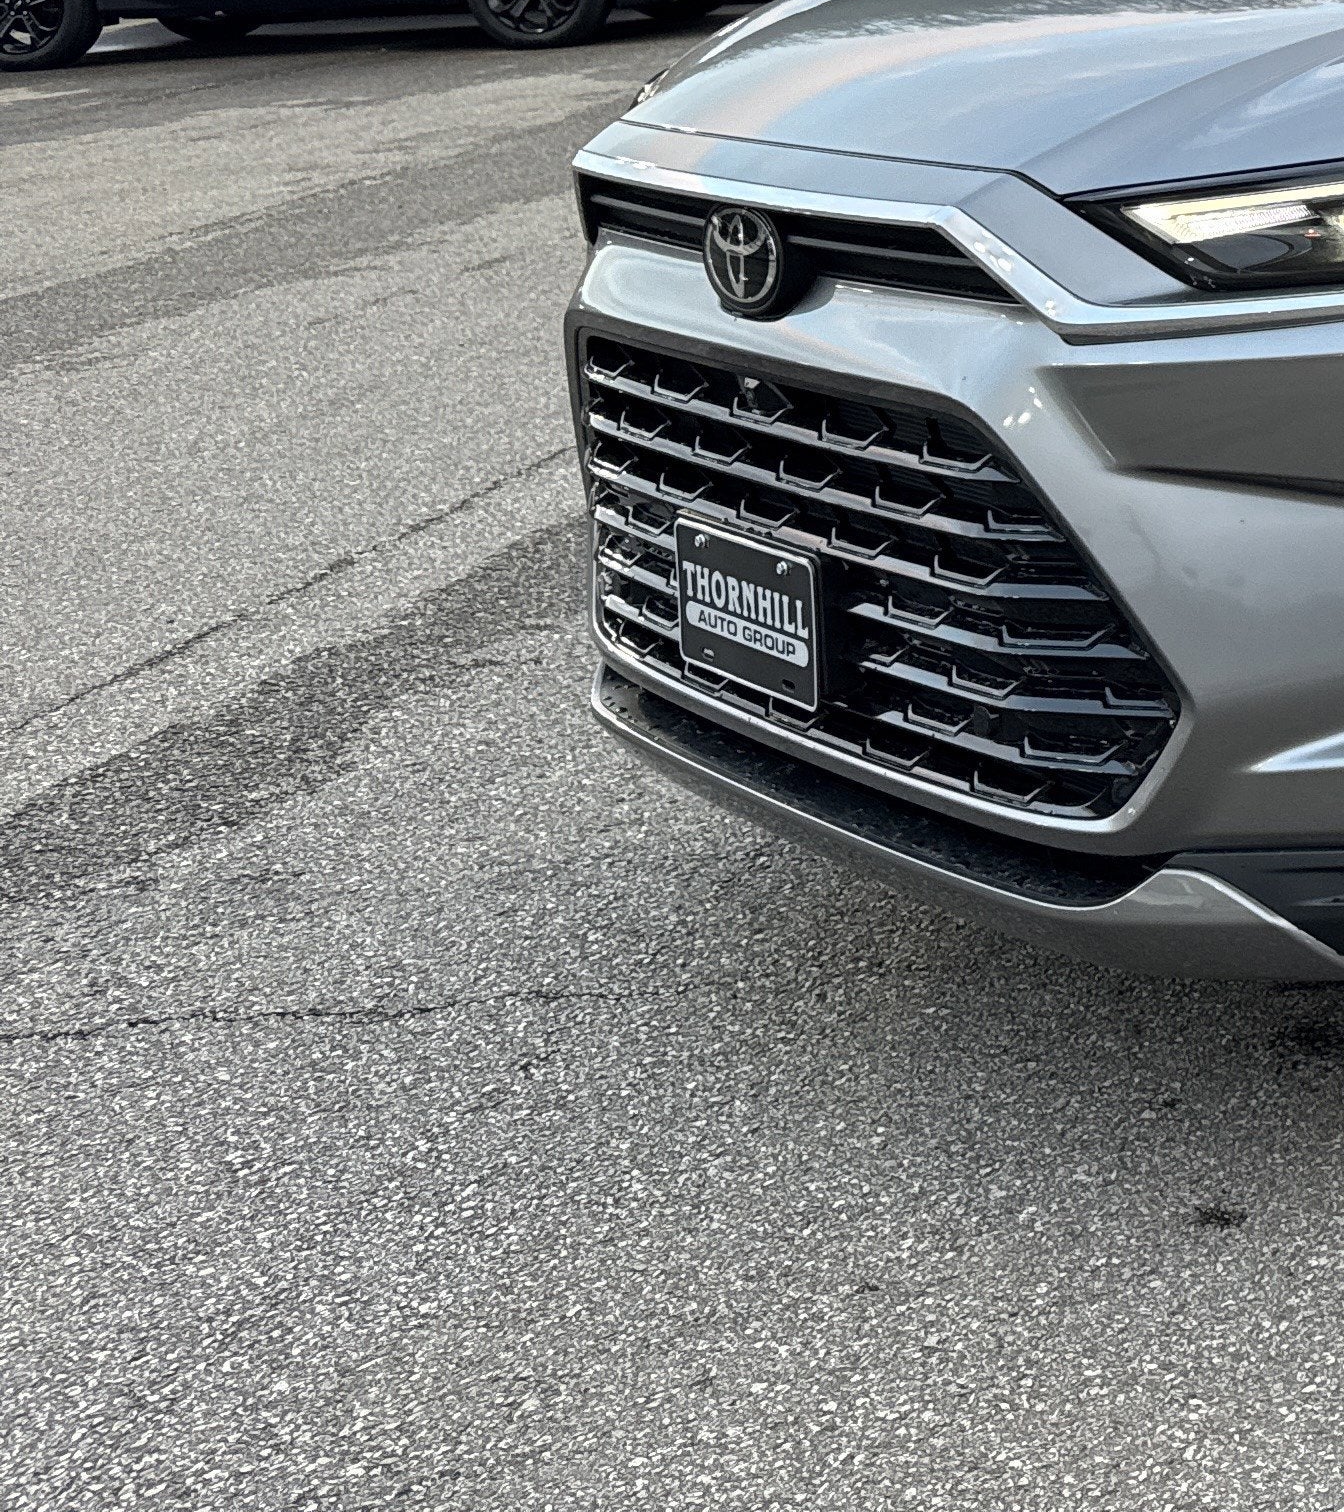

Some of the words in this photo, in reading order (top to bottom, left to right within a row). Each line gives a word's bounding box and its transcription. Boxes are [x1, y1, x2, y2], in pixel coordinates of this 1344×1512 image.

[682, 560, 809, 639] THORNHILL
[698, 610, 738, 637] AUTO
[742, 626, 796, 657] GROUP
